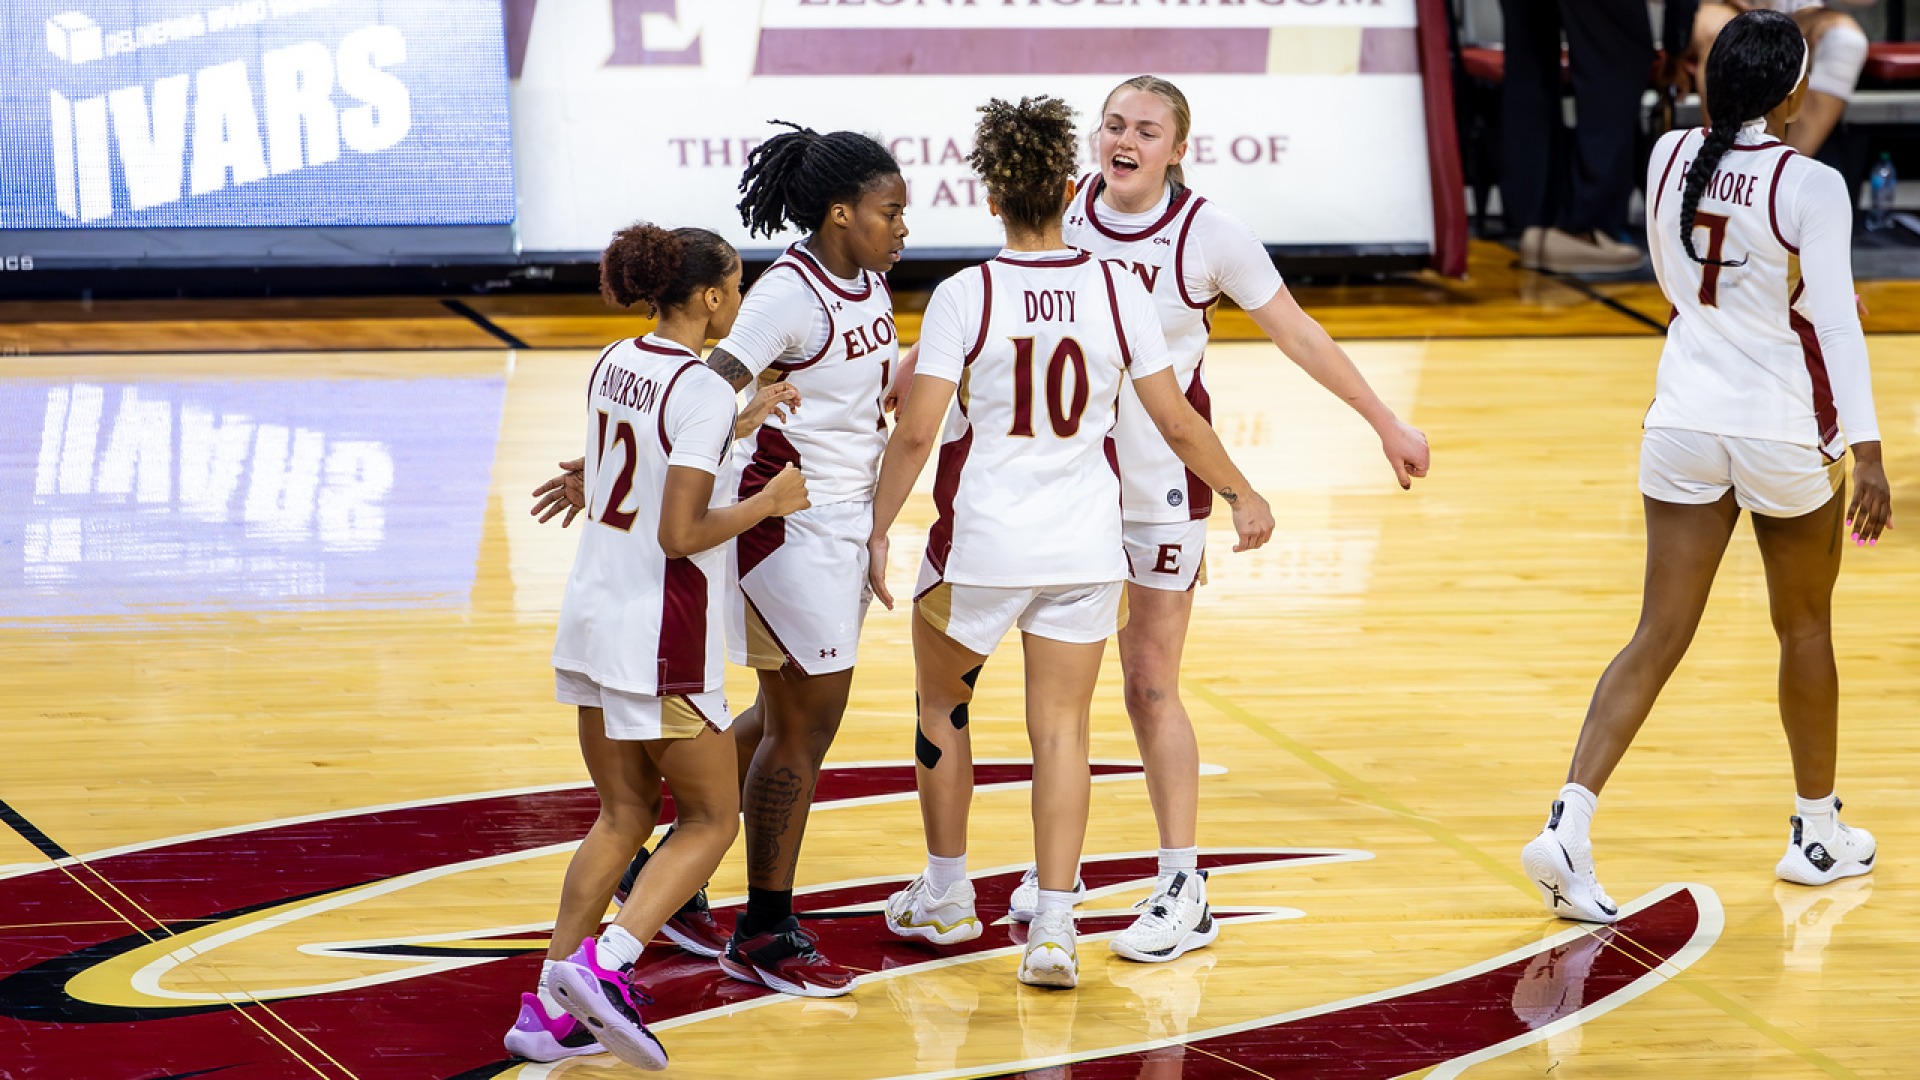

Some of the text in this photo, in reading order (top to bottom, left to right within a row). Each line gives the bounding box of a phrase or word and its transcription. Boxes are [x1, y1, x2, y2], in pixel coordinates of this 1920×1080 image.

[602, 0, 702, 67] E
[1230, 135, 1289, 164] OF
[1677, 160, 1758, 207] FMORE
[1692, 208, 1730, 309] 7
[1024, 290, 1076, 323] DOTY
[599, 362, 662, 415] ANDERSON
[1007, 336, 1089, 439] 10
[588, 408, 640, 533] 12
[1151, 544, 1182, 574] E
